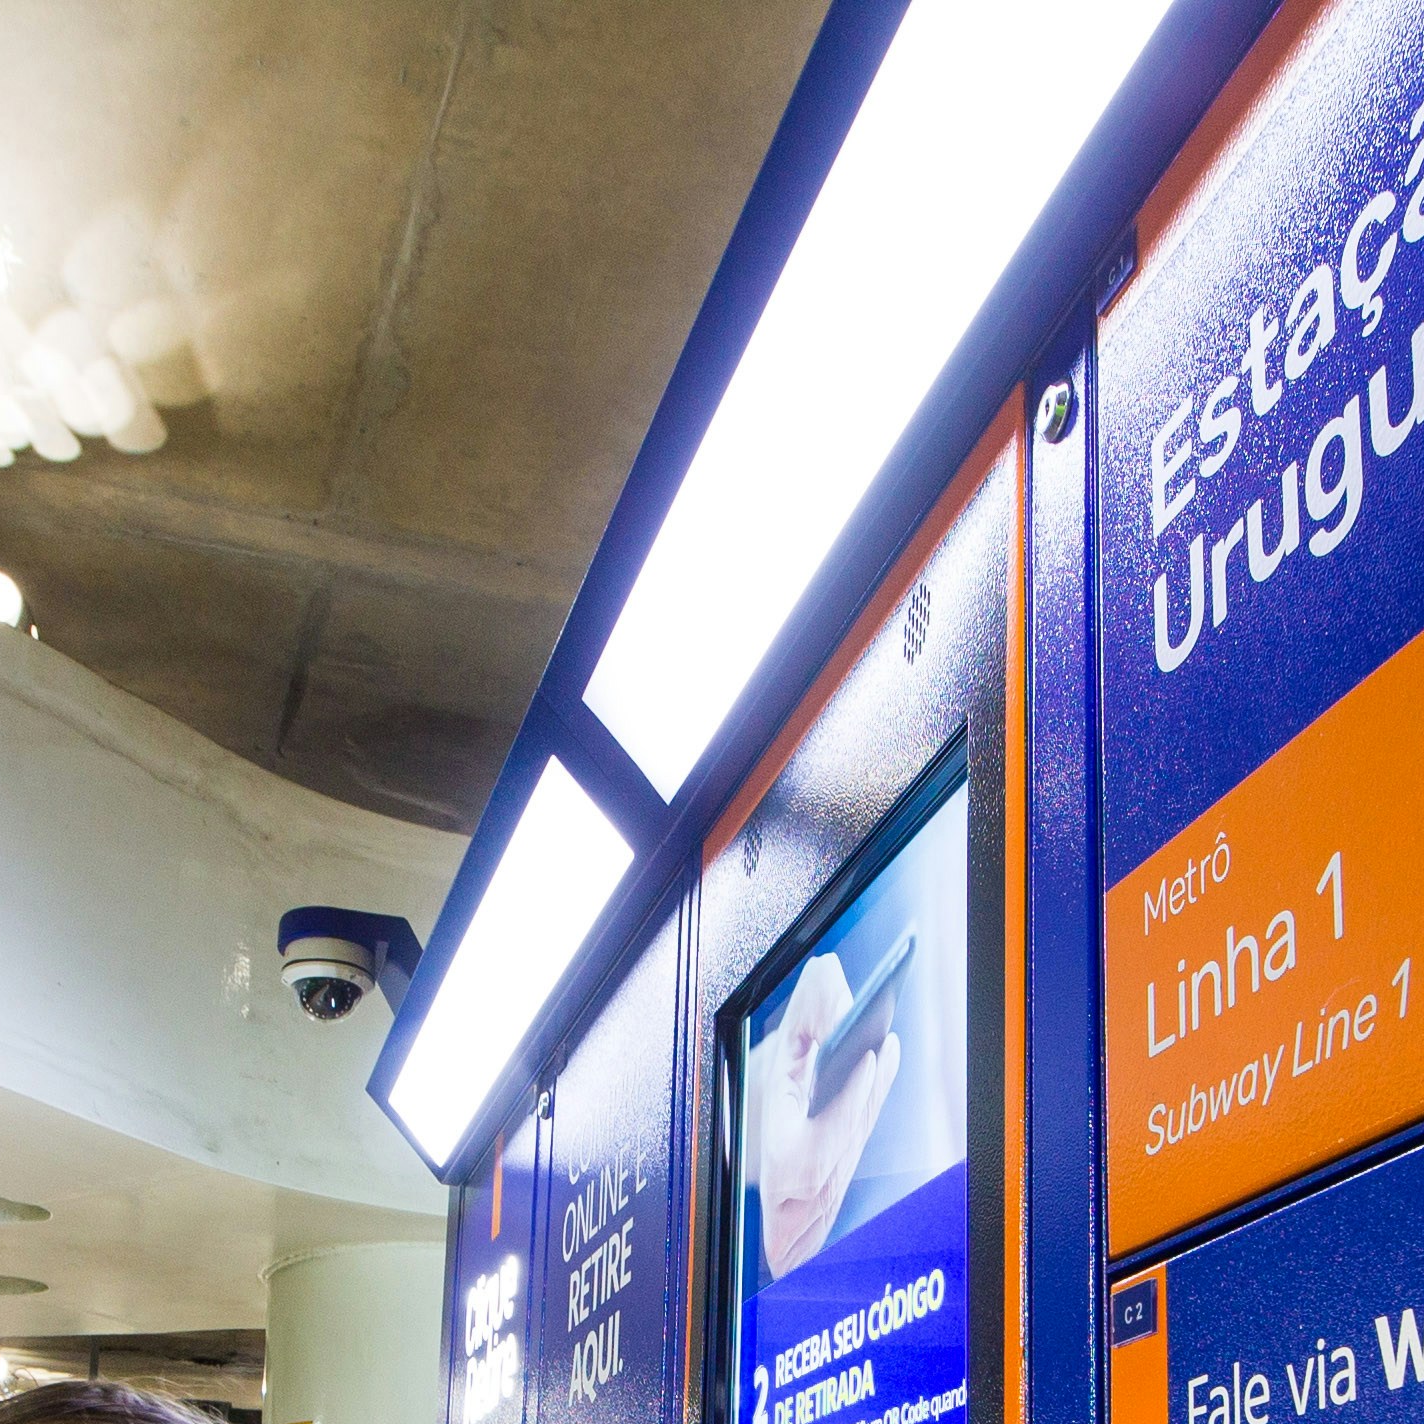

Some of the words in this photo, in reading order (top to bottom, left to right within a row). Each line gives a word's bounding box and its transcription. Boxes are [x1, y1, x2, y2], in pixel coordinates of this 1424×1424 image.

[1143, 831, 1231, 936] Metrô
[1146, 910, 1296, 1058] Linha
[1316, 851, 1344, 939] 1
[1144, 1043, 1284, 1156] Subway
[1291, 993, 1378, 1077] Line
[1391, 957, 1412, 1018] 1
[562, 1141, 629, 1263] ONLINE
[568, 1219, 634, 1332] RETIRE
[776, 1327, 832, 1389] RECEBA
[833, 1308, 865, 1360] SEU
[867, 1267, 945, 1342] CÓDIGO
[568, 1310, 624, 1407] AQUI.
[1287, 1339, 1358, 1416] via
